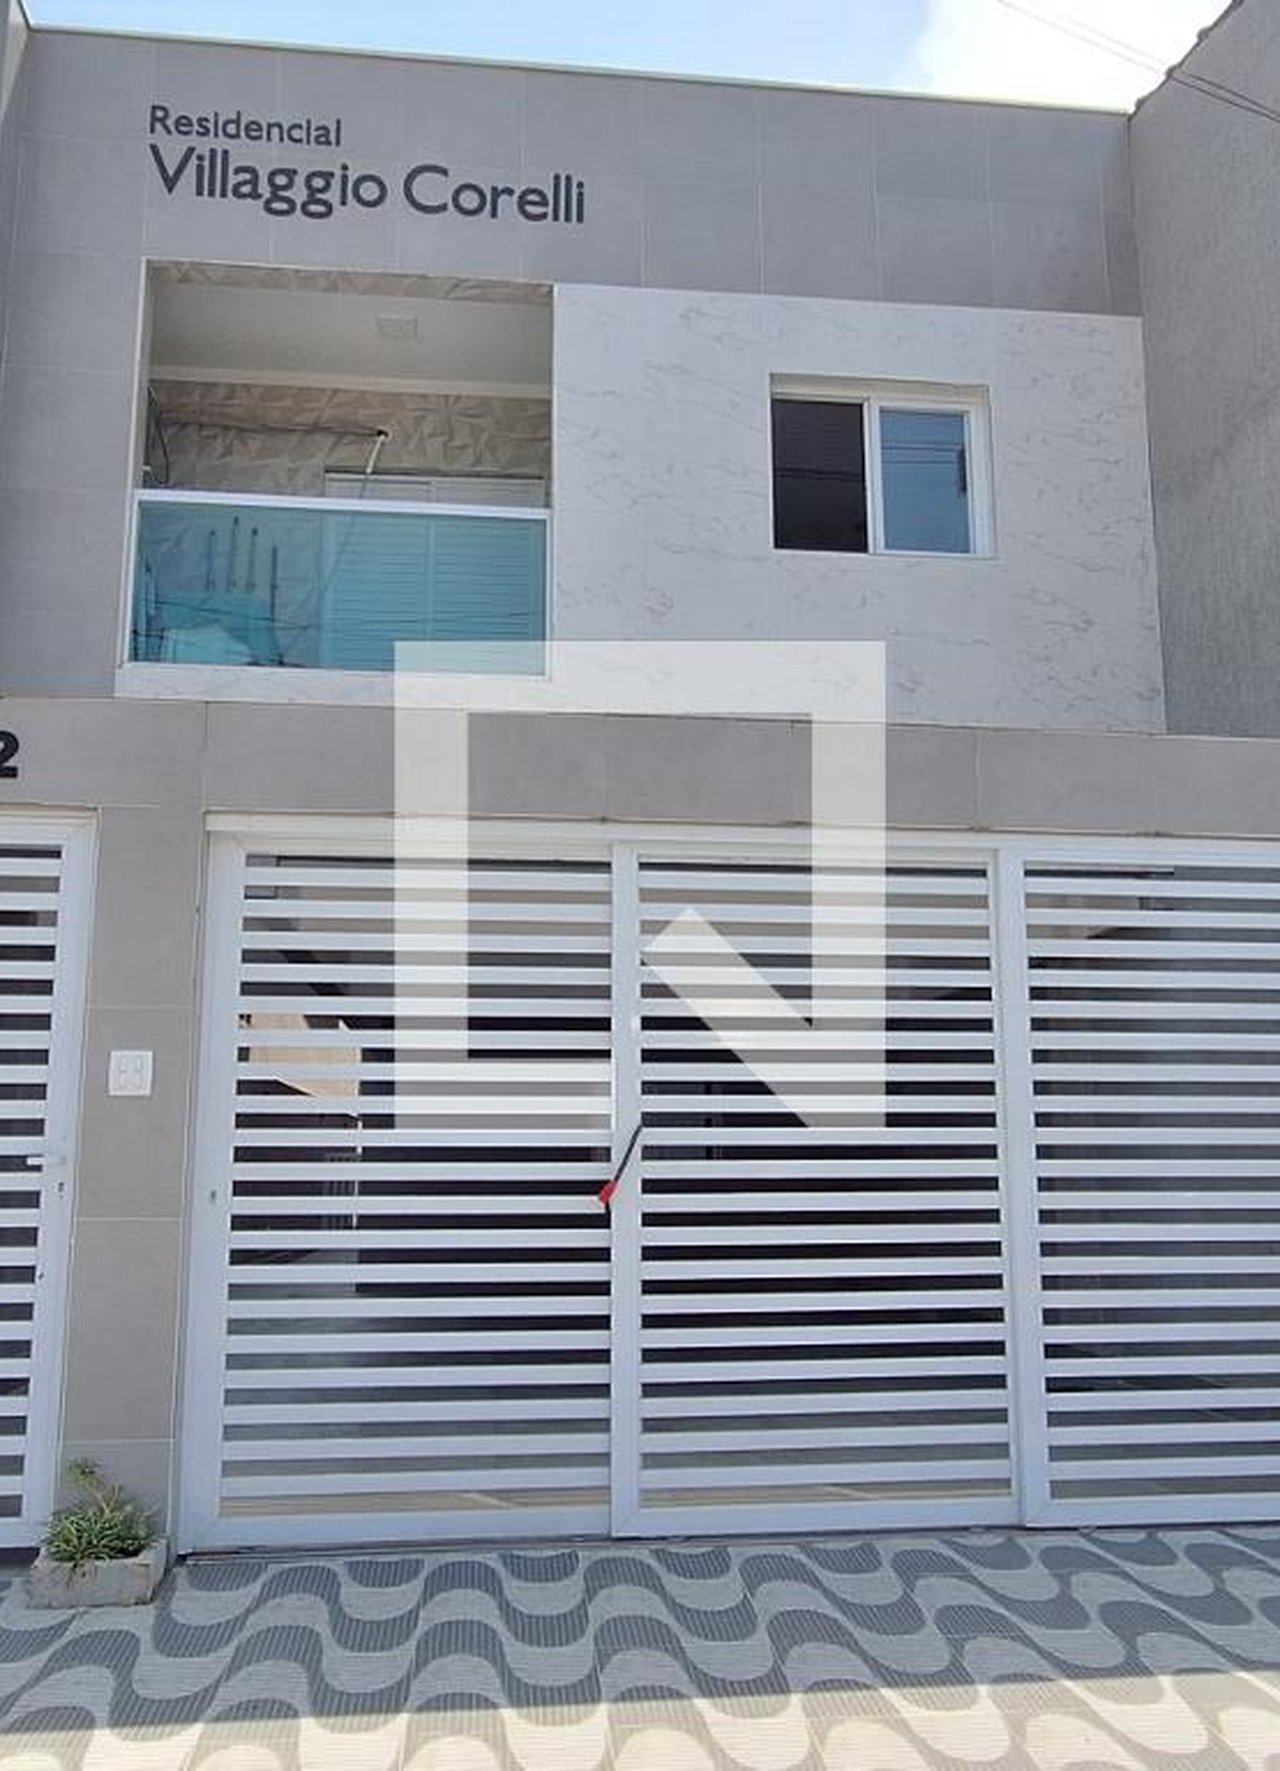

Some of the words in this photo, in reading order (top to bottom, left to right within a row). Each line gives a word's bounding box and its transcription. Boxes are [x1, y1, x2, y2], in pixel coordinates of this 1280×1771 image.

[149, 104, 342, 148] Residencial
[149, 142, 389, 220] Villaggio
[403, 164, 586, 225] Corelli
